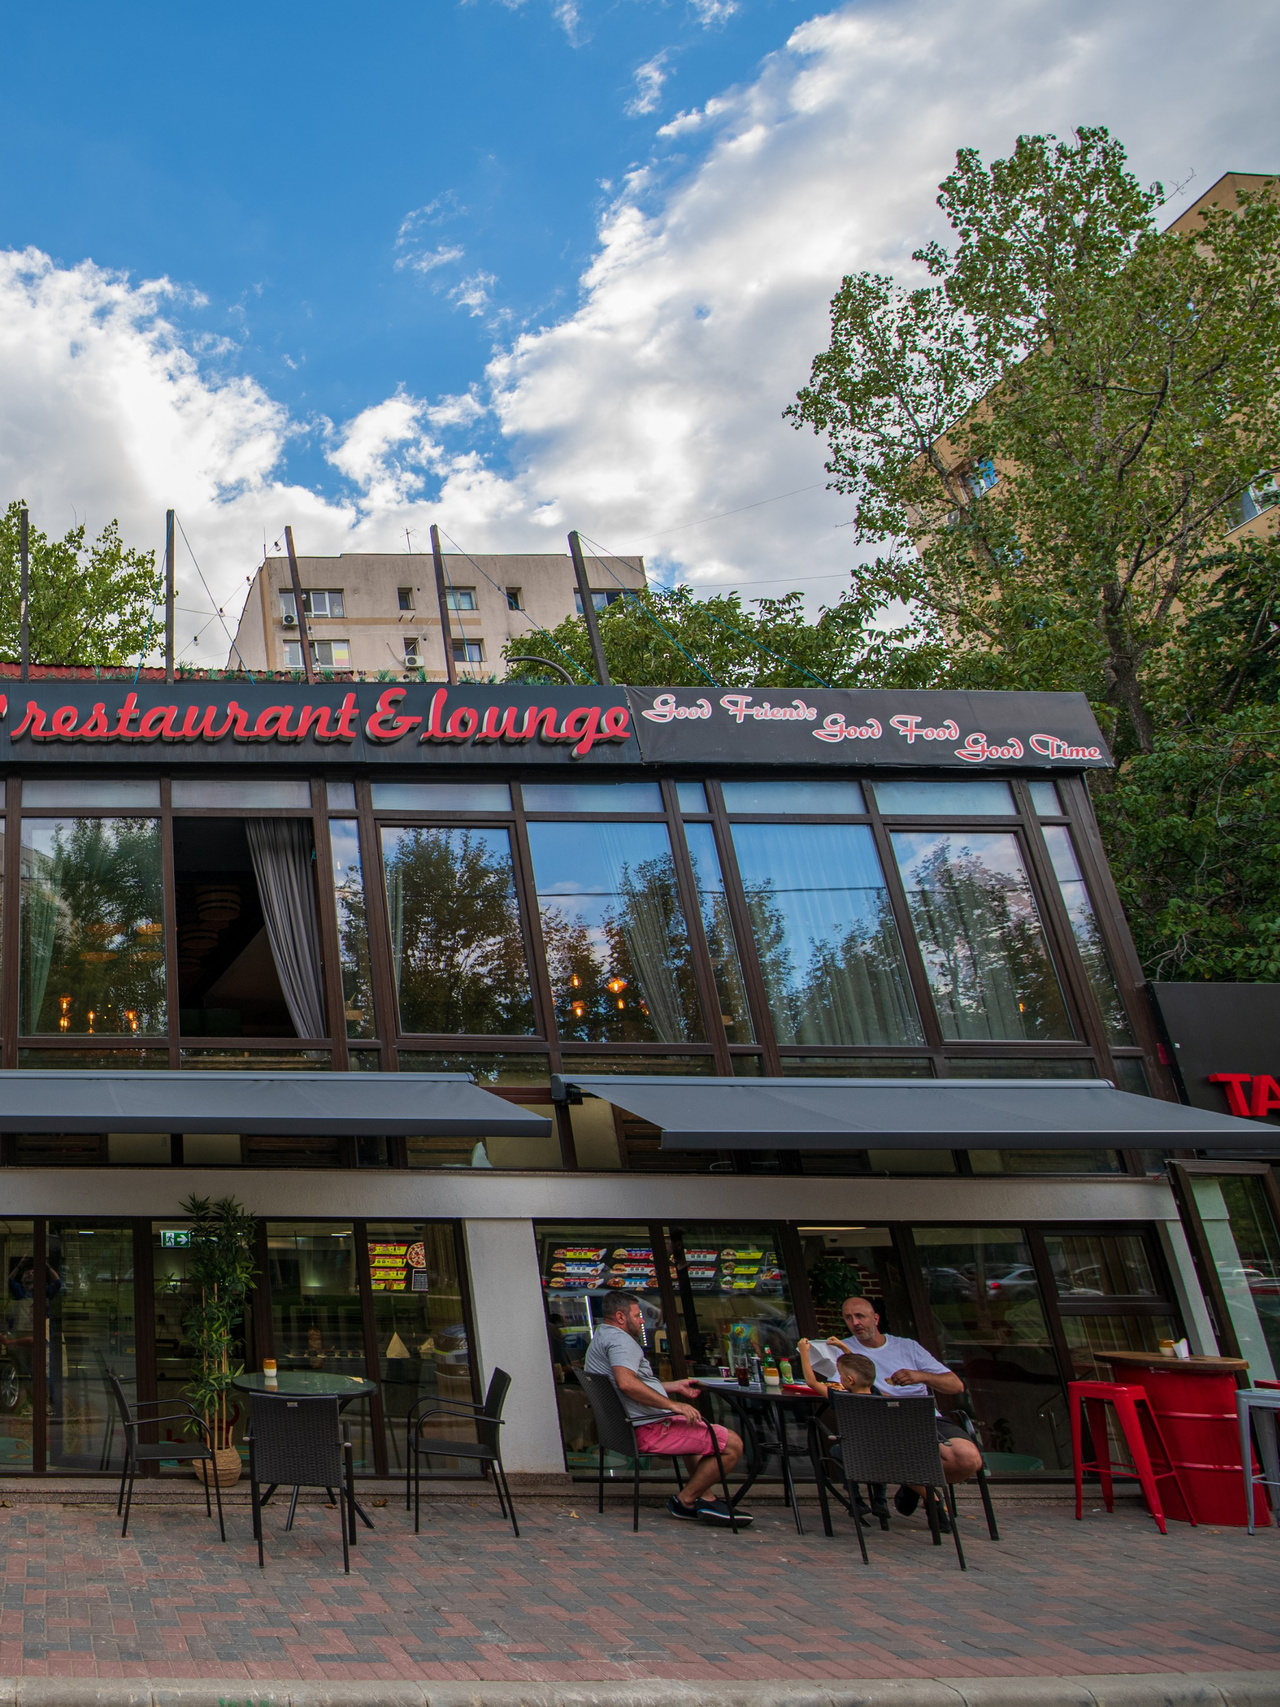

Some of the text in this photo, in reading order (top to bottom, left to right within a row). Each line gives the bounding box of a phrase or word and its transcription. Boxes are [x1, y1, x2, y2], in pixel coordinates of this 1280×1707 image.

[10, 692, 360, 743] restaurant
[365, 687, 423, 743] &
[418, 687, 631, 759] lounge
[641, 693, 818, 723] Good Friends
[811, 713, 960, 744] Good Food
[954, 732, 1104, 763] Good Time
